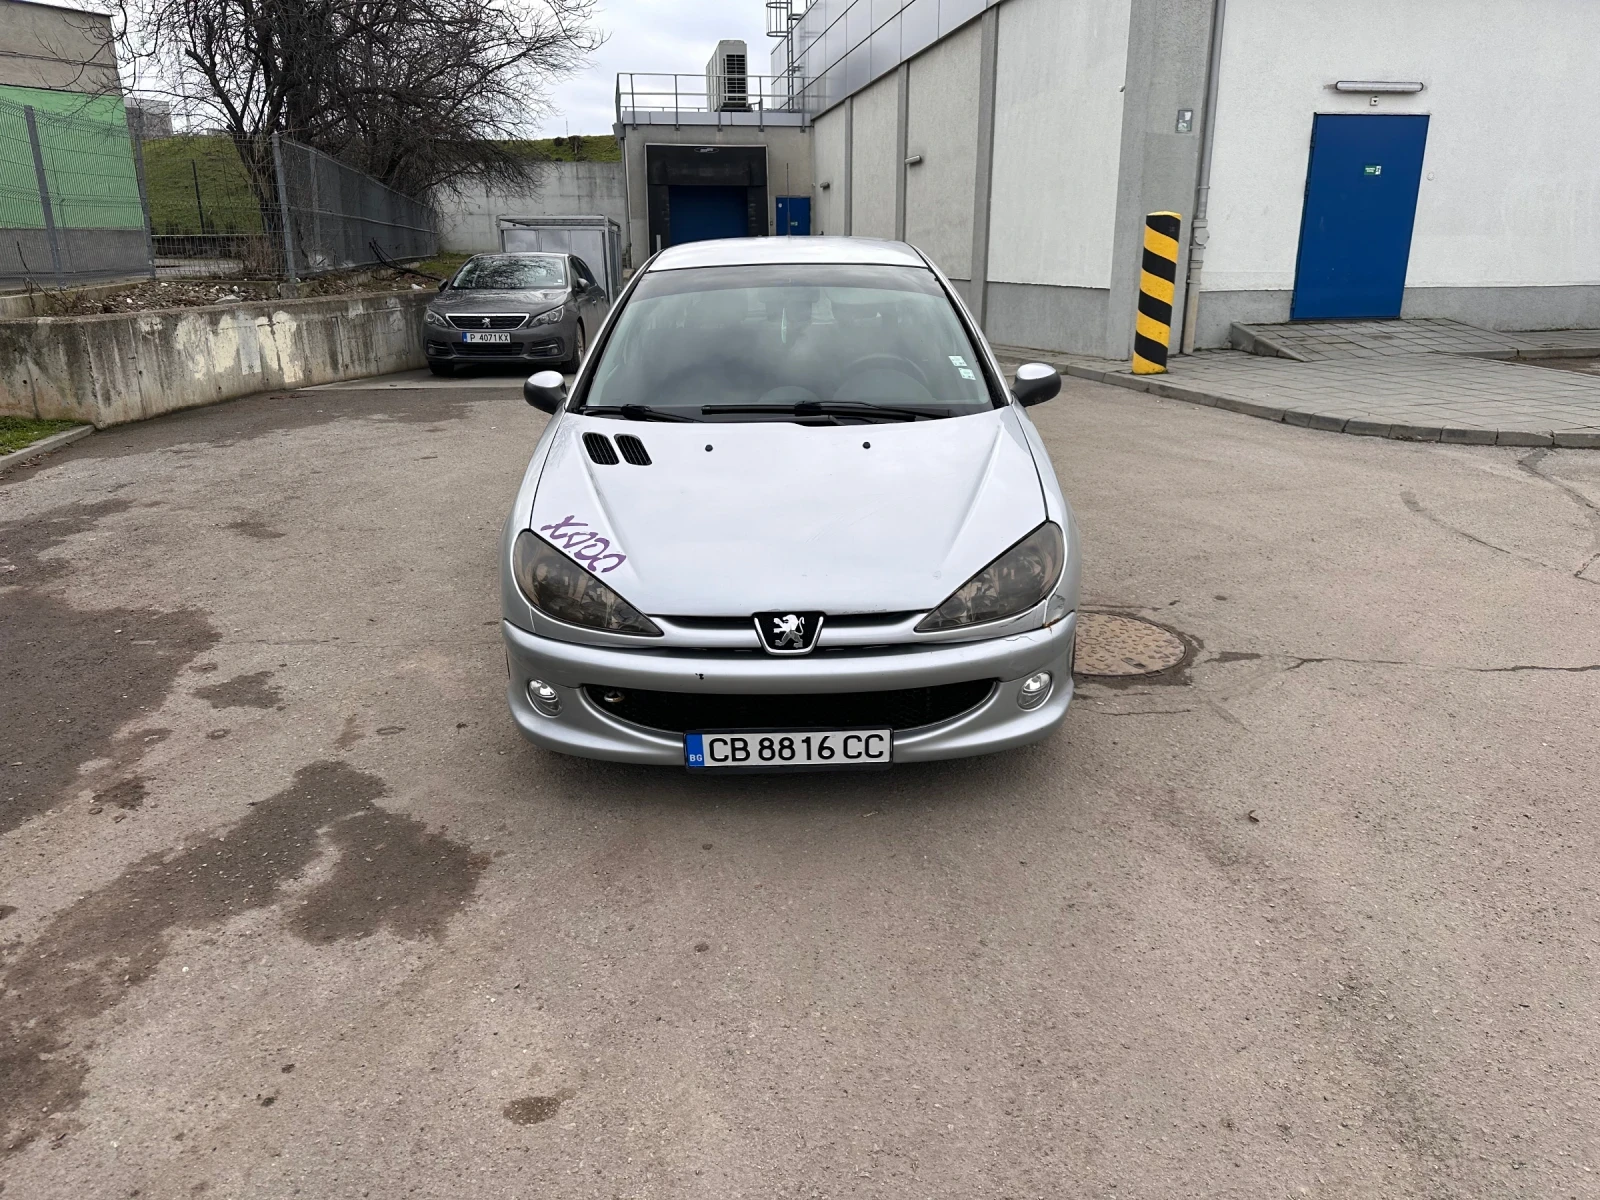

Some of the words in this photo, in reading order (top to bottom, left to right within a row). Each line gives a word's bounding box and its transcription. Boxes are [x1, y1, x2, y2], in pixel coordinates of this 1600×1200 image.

[470, 334, 476, 342] P
[708, 737, 751, 762] CB
[758, 735, 835, 761] 8816
[843, 734, 884, 759] CC
[689, 754, 703, 762] BG
